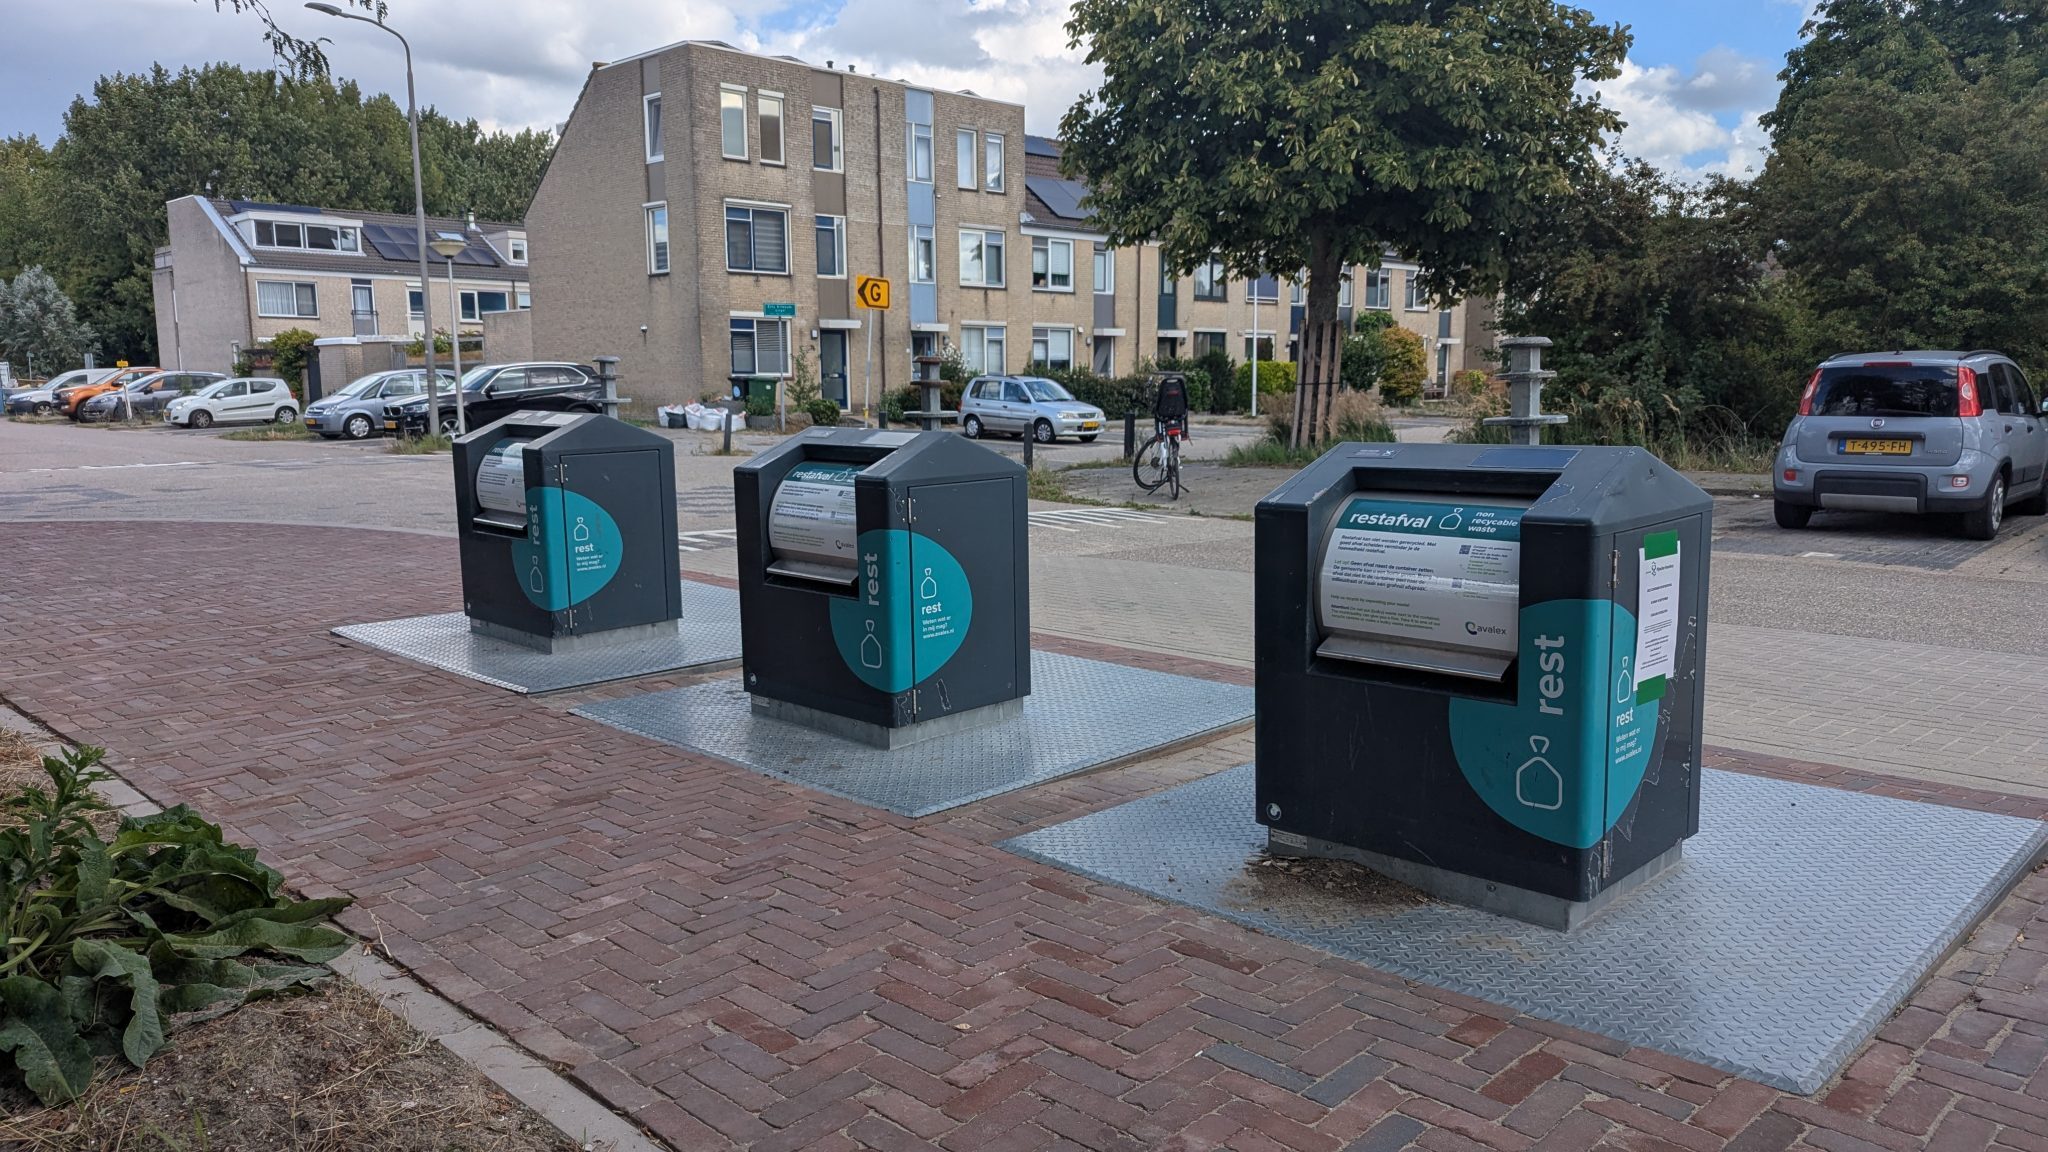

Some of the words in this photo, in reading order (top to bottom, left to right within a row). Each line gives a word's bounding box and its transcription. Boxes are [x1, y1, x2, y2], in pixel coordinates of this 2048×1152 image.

[870, 283, 881, 302] G
[1850, 441, 1907, 452] T-495-FH
[792, 471, 834, 480] restafval
[530, 504, 541, 545] rest
[1349, 512, 1433, 529] restafval
[1471, 518, 1518, 527] recycable
[575, 543, 594, 553] rest
[864, 552, 880, 606] rest
[921, 601, 942, 615] rest
[1535, 634, 1566, 716] rest
[1616, 706, 1634, 728] rest
